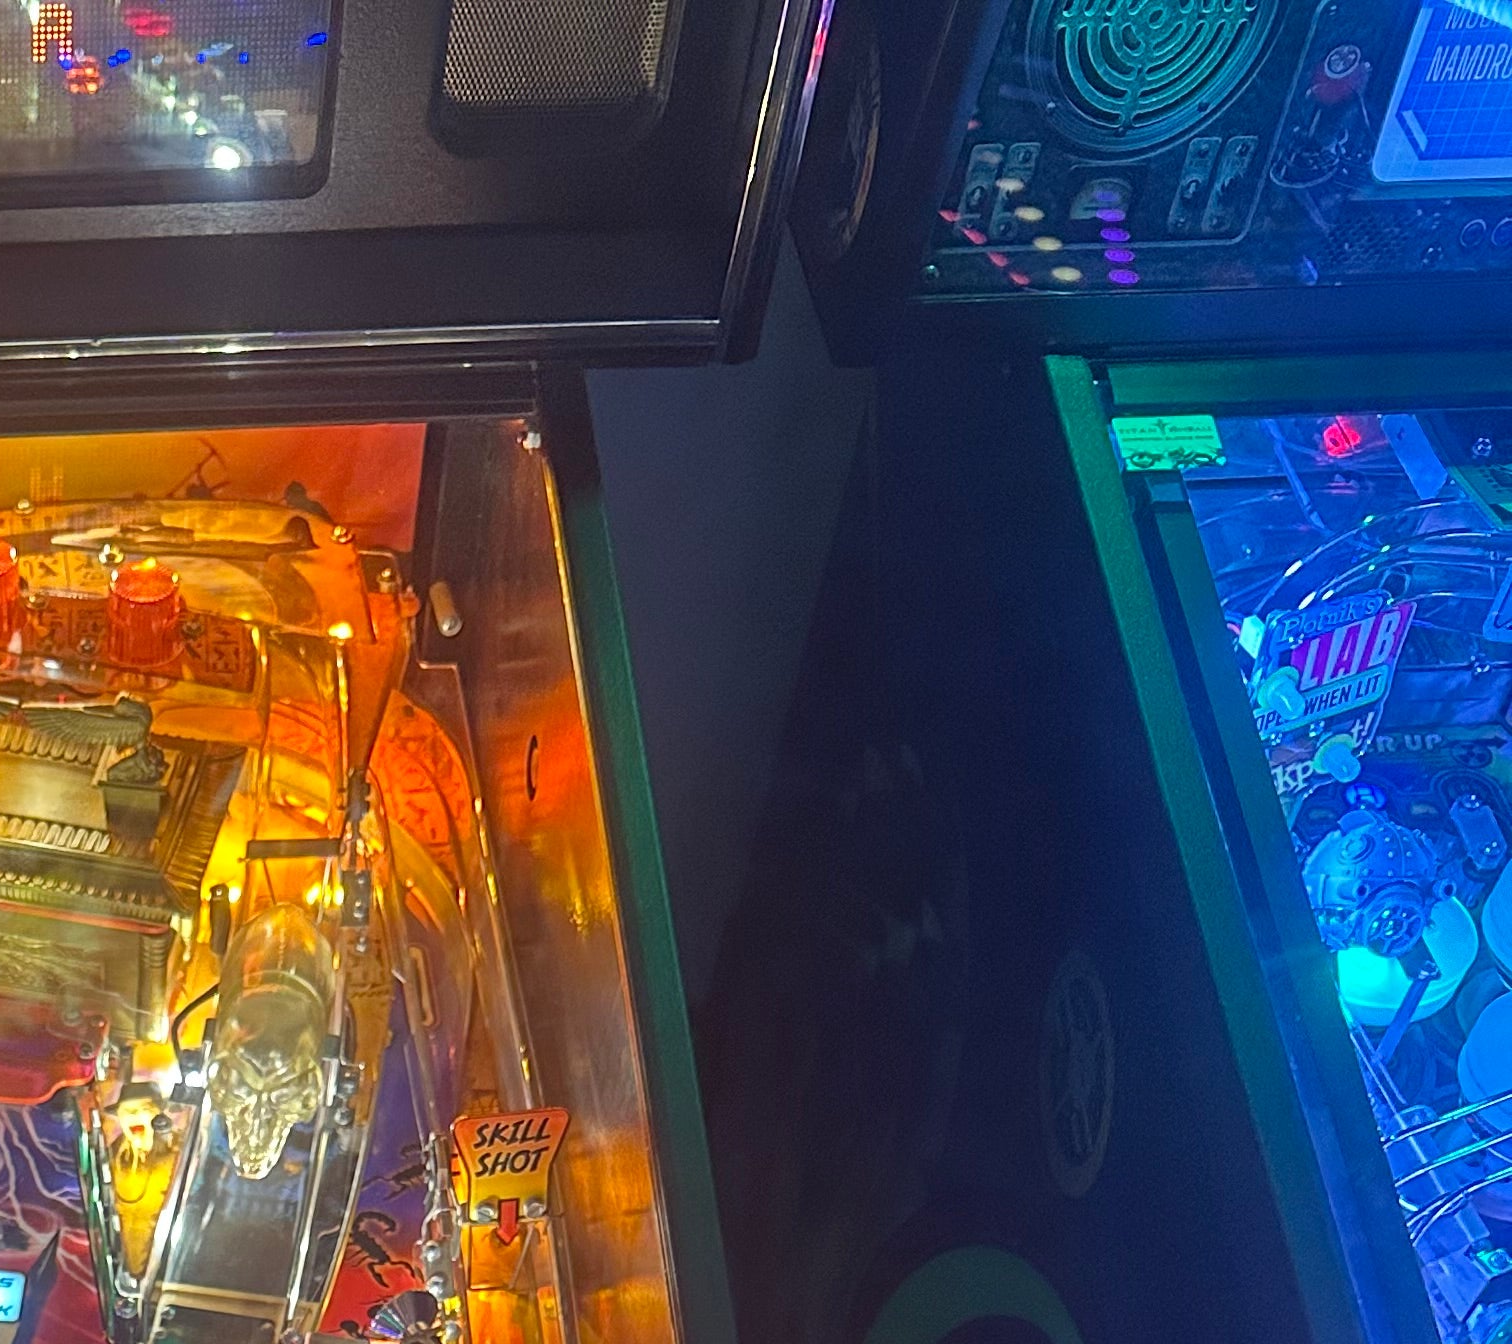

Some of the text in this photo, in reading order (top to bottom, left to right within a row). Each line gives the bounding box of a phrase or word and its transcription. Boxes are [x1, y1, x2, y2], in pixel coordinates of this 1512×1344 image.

[1283, 600, 1377, 638] Plotnik's
[1300, 612, 1400, 690] LAB
[1303, 673, 1381, 716] WHEN LIT
[473, 1118, 552, 1149] SKILL
[474, 1150, 545, 1178] SHOT
